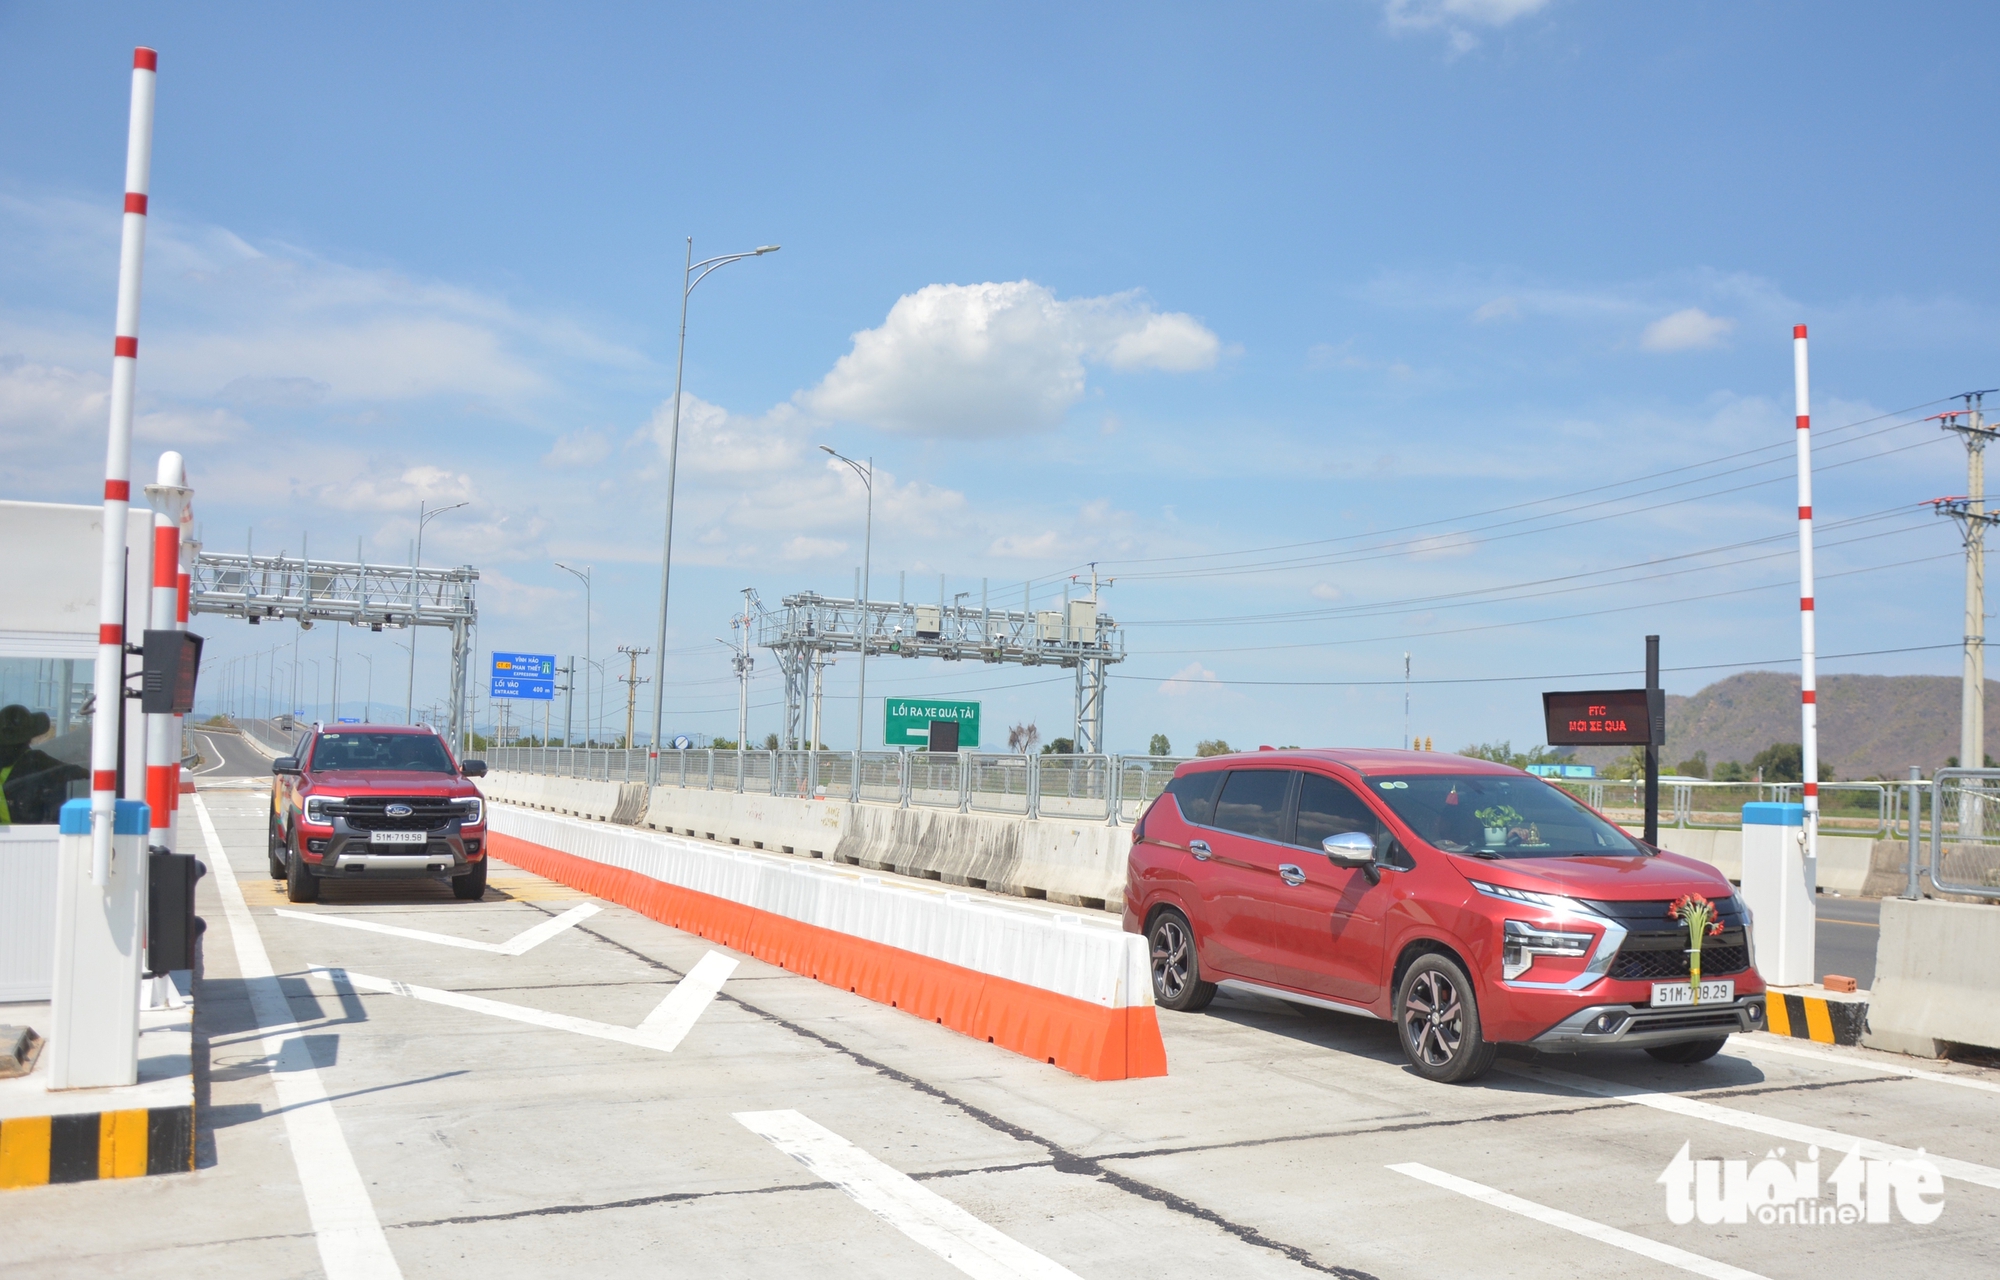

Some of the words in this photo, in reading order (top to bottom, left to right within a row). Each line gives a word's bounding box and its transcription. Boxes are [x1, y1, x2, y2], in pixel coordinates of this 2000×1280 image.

[494, 679, 505, 687] LỐI
[507, 680, 519, 688] VÀO
[892, 702, 908, 716] LỐI
[910, 706, 923, 717] RA
[925, 707, 937, 718] XE
[938, 706, 958, 718] QUÁ
[960, 706, 974, 719] TẢI
[1588, 705, 1607, 716] ETC
[1589, 720, 1603, 732] XE
[1605, 720, 1627, 732] QUA
